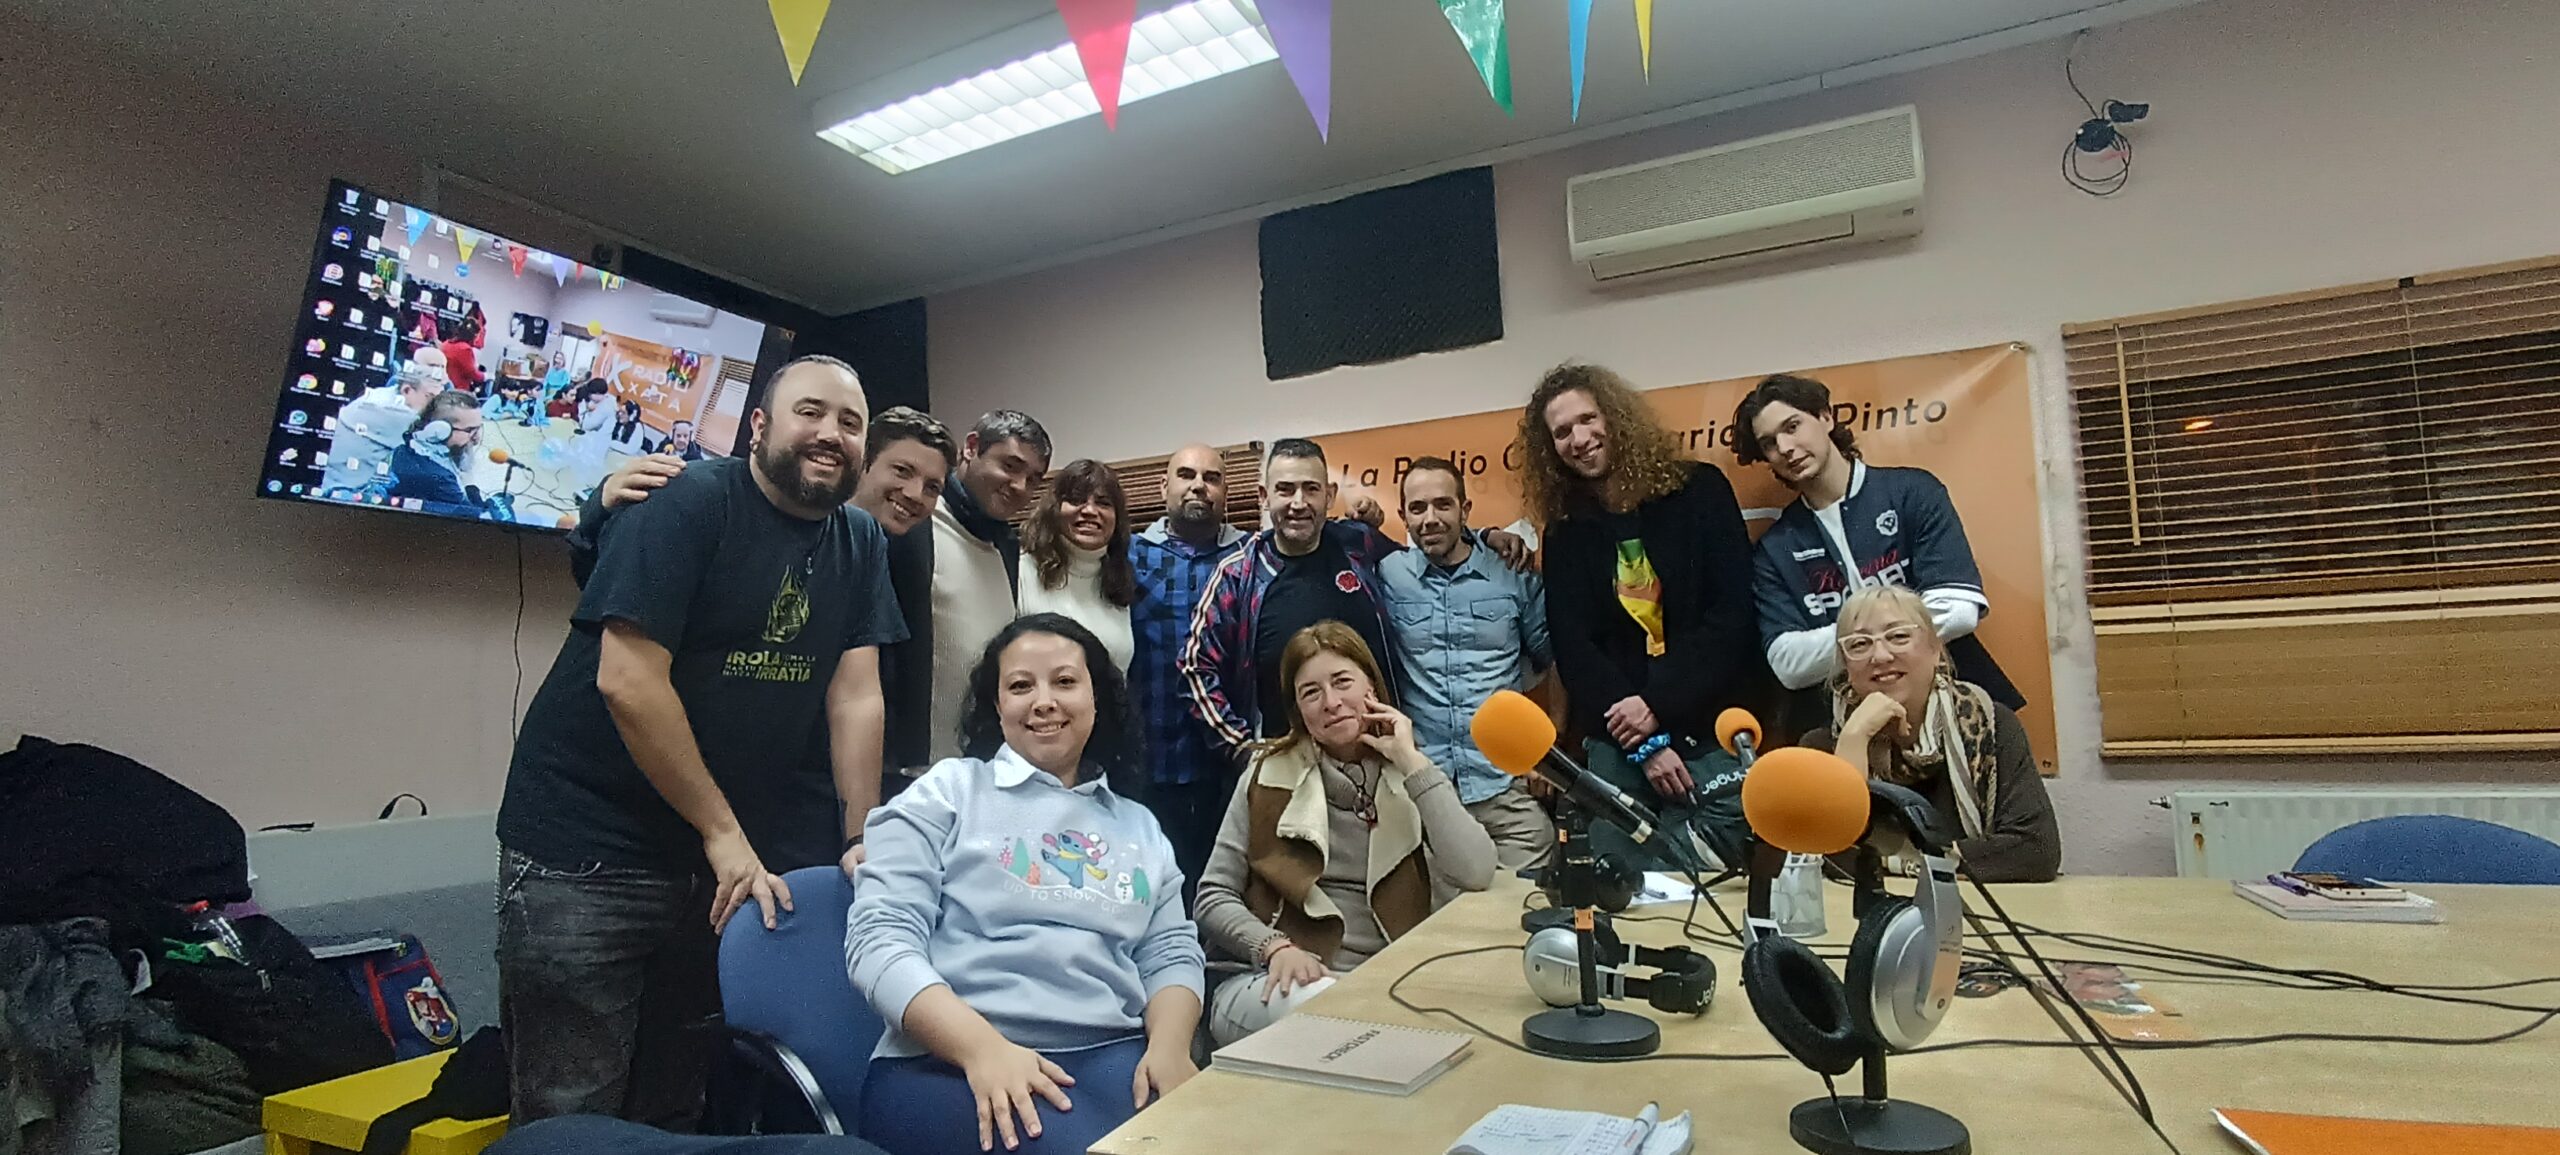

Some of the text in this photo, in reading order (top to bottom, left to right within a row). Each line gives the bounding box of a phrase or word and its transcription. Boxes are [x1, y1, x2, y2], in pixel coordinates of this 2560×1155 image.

[1833, 398, 1947, 432] Pinto
[1340, 449, 1488, 488] La Rio
[726, 650, 780, 666] IROLA
[755, 665, 811, 682] IRRATIA
